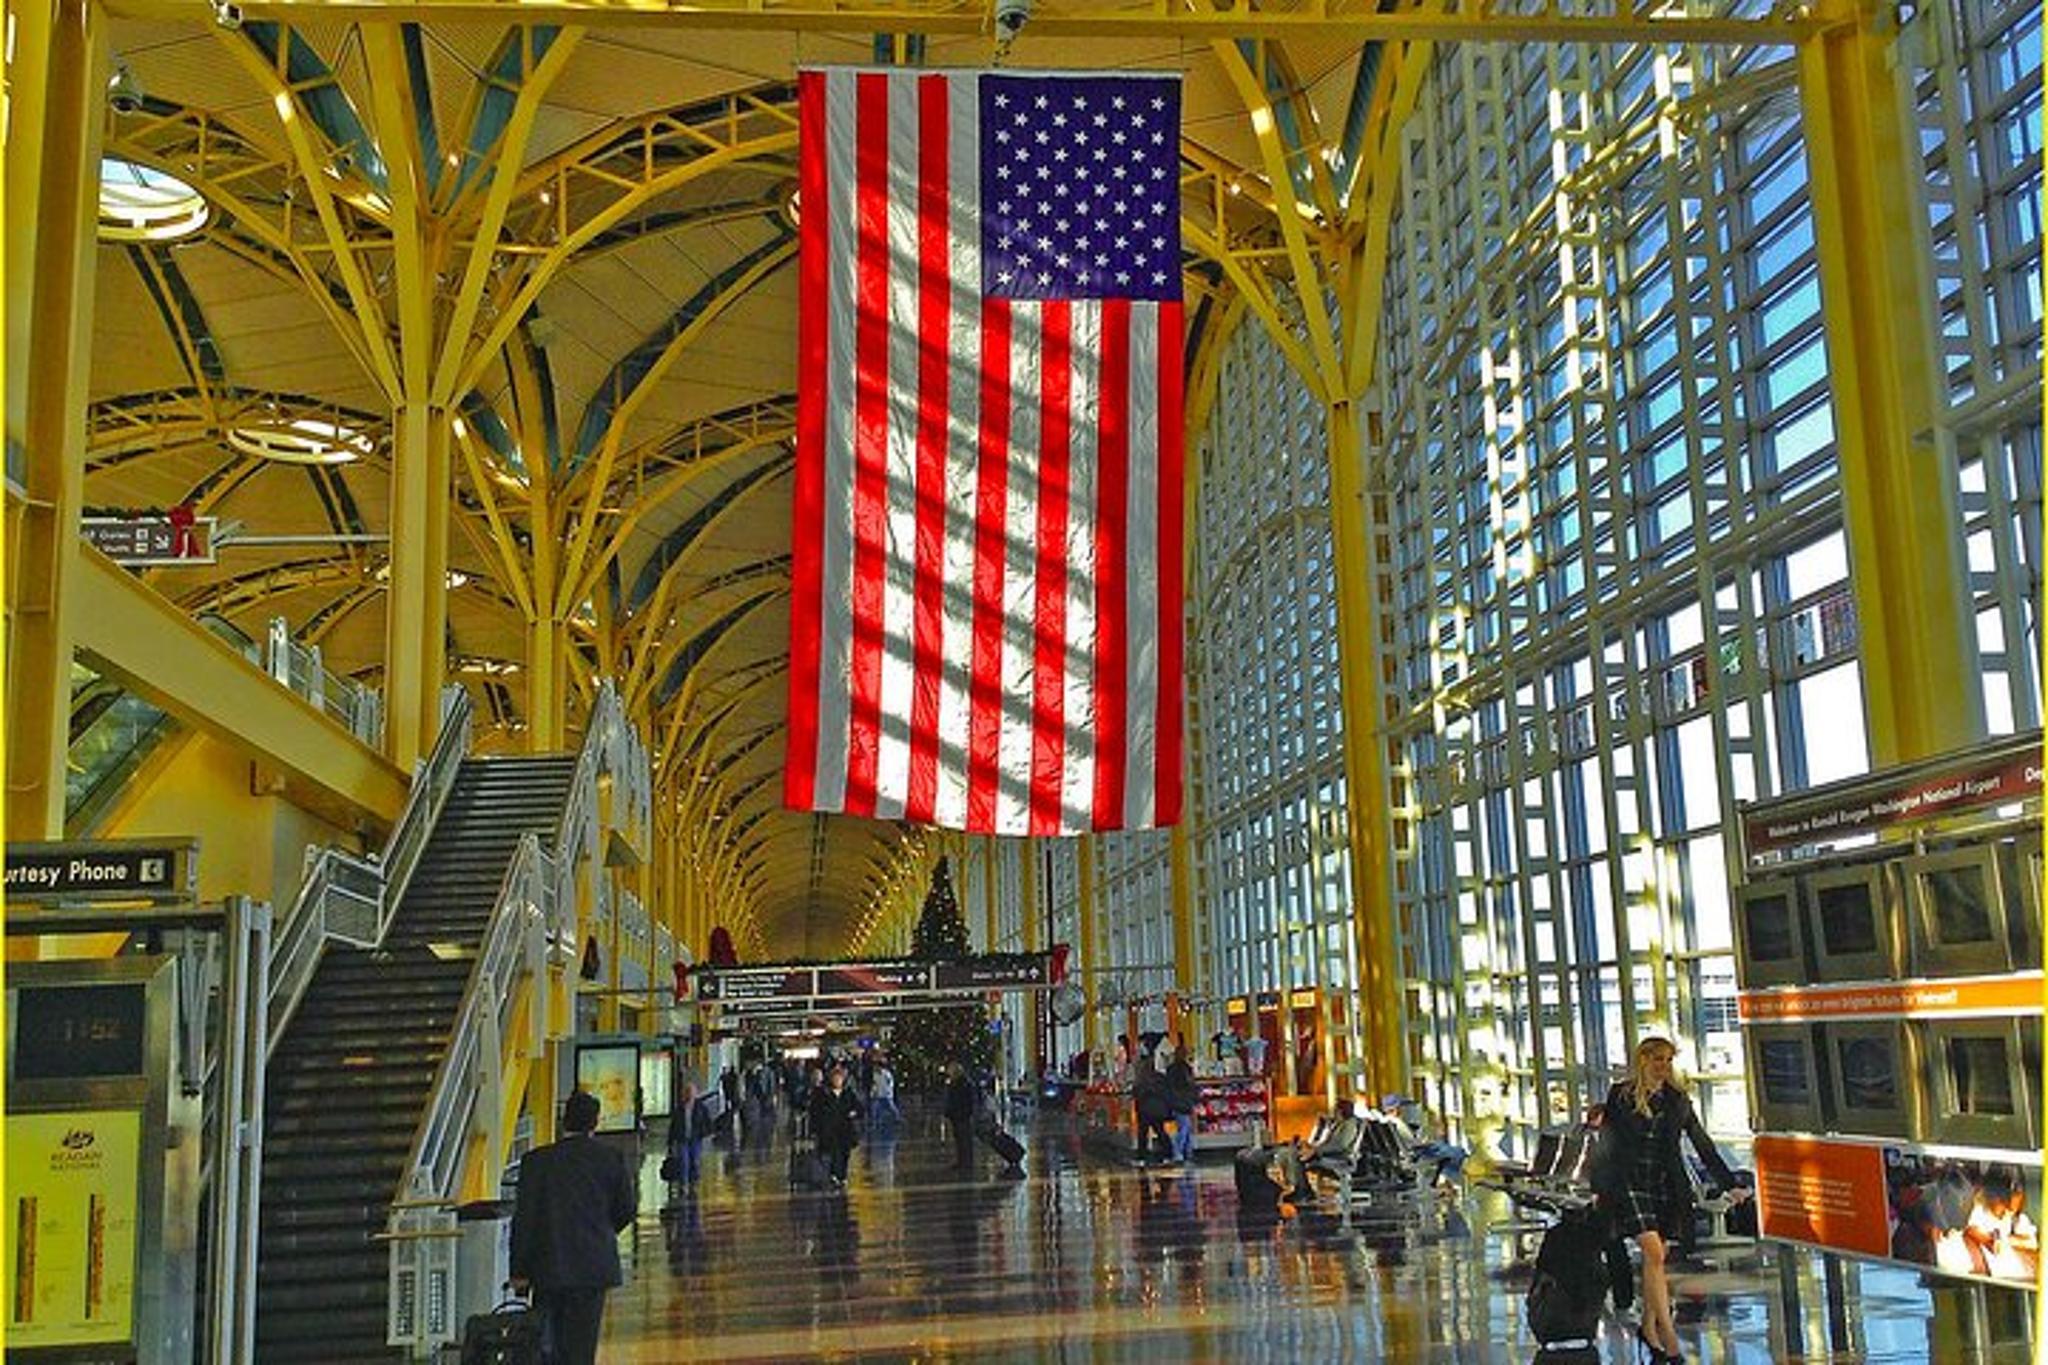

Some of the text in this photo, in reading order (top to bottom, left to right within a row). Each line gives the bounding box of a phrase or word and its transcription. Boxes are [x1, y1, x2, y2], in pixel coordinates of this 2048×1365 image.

[1872, 795, 1920, 815] Washington
[1922, 781, 1962, 804] National
[1964, 776, 2000, 794] Airport
[69, 860, 128, 882] Phone
[50, 1151, 103, 1161] REAGAN
